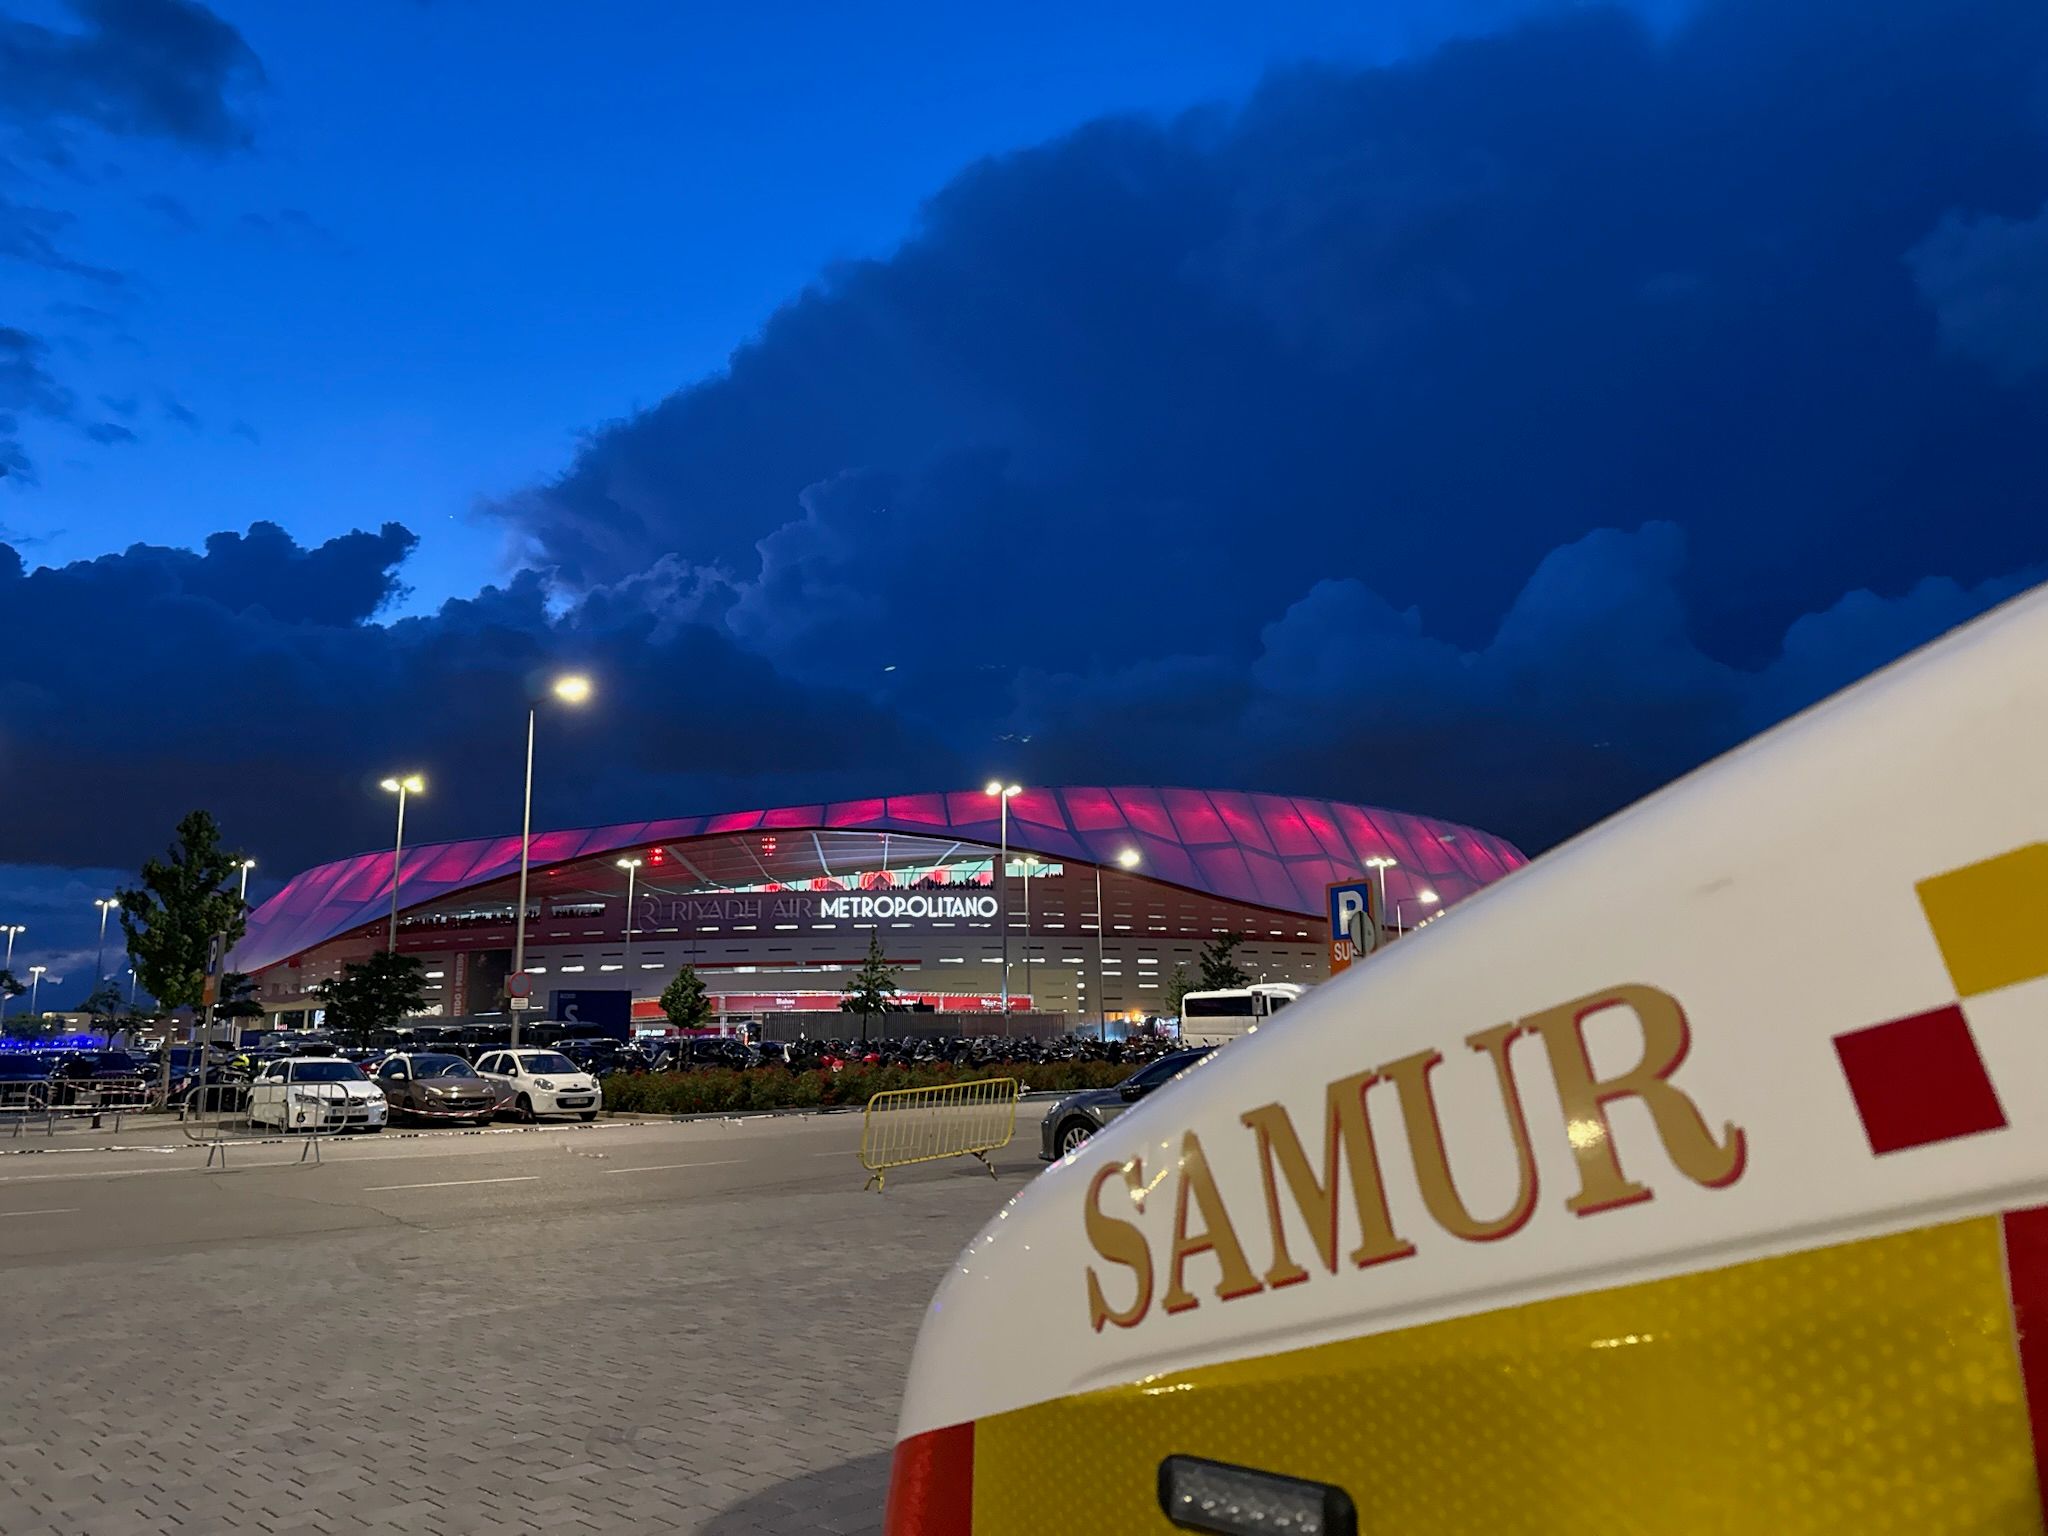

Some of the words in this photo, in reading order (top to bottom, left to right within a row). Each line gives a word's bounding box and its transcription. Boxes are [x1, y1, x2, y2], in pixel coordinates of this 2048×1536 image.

[671, 900, 762, 921] RIYADH
[769, 898, 813, 920] AIR
[820, 896, 999, 919] METROPOLITANO
[1338, 890, 1364, 935] P
[1084, 983, 1747, 1333] SAMUR
